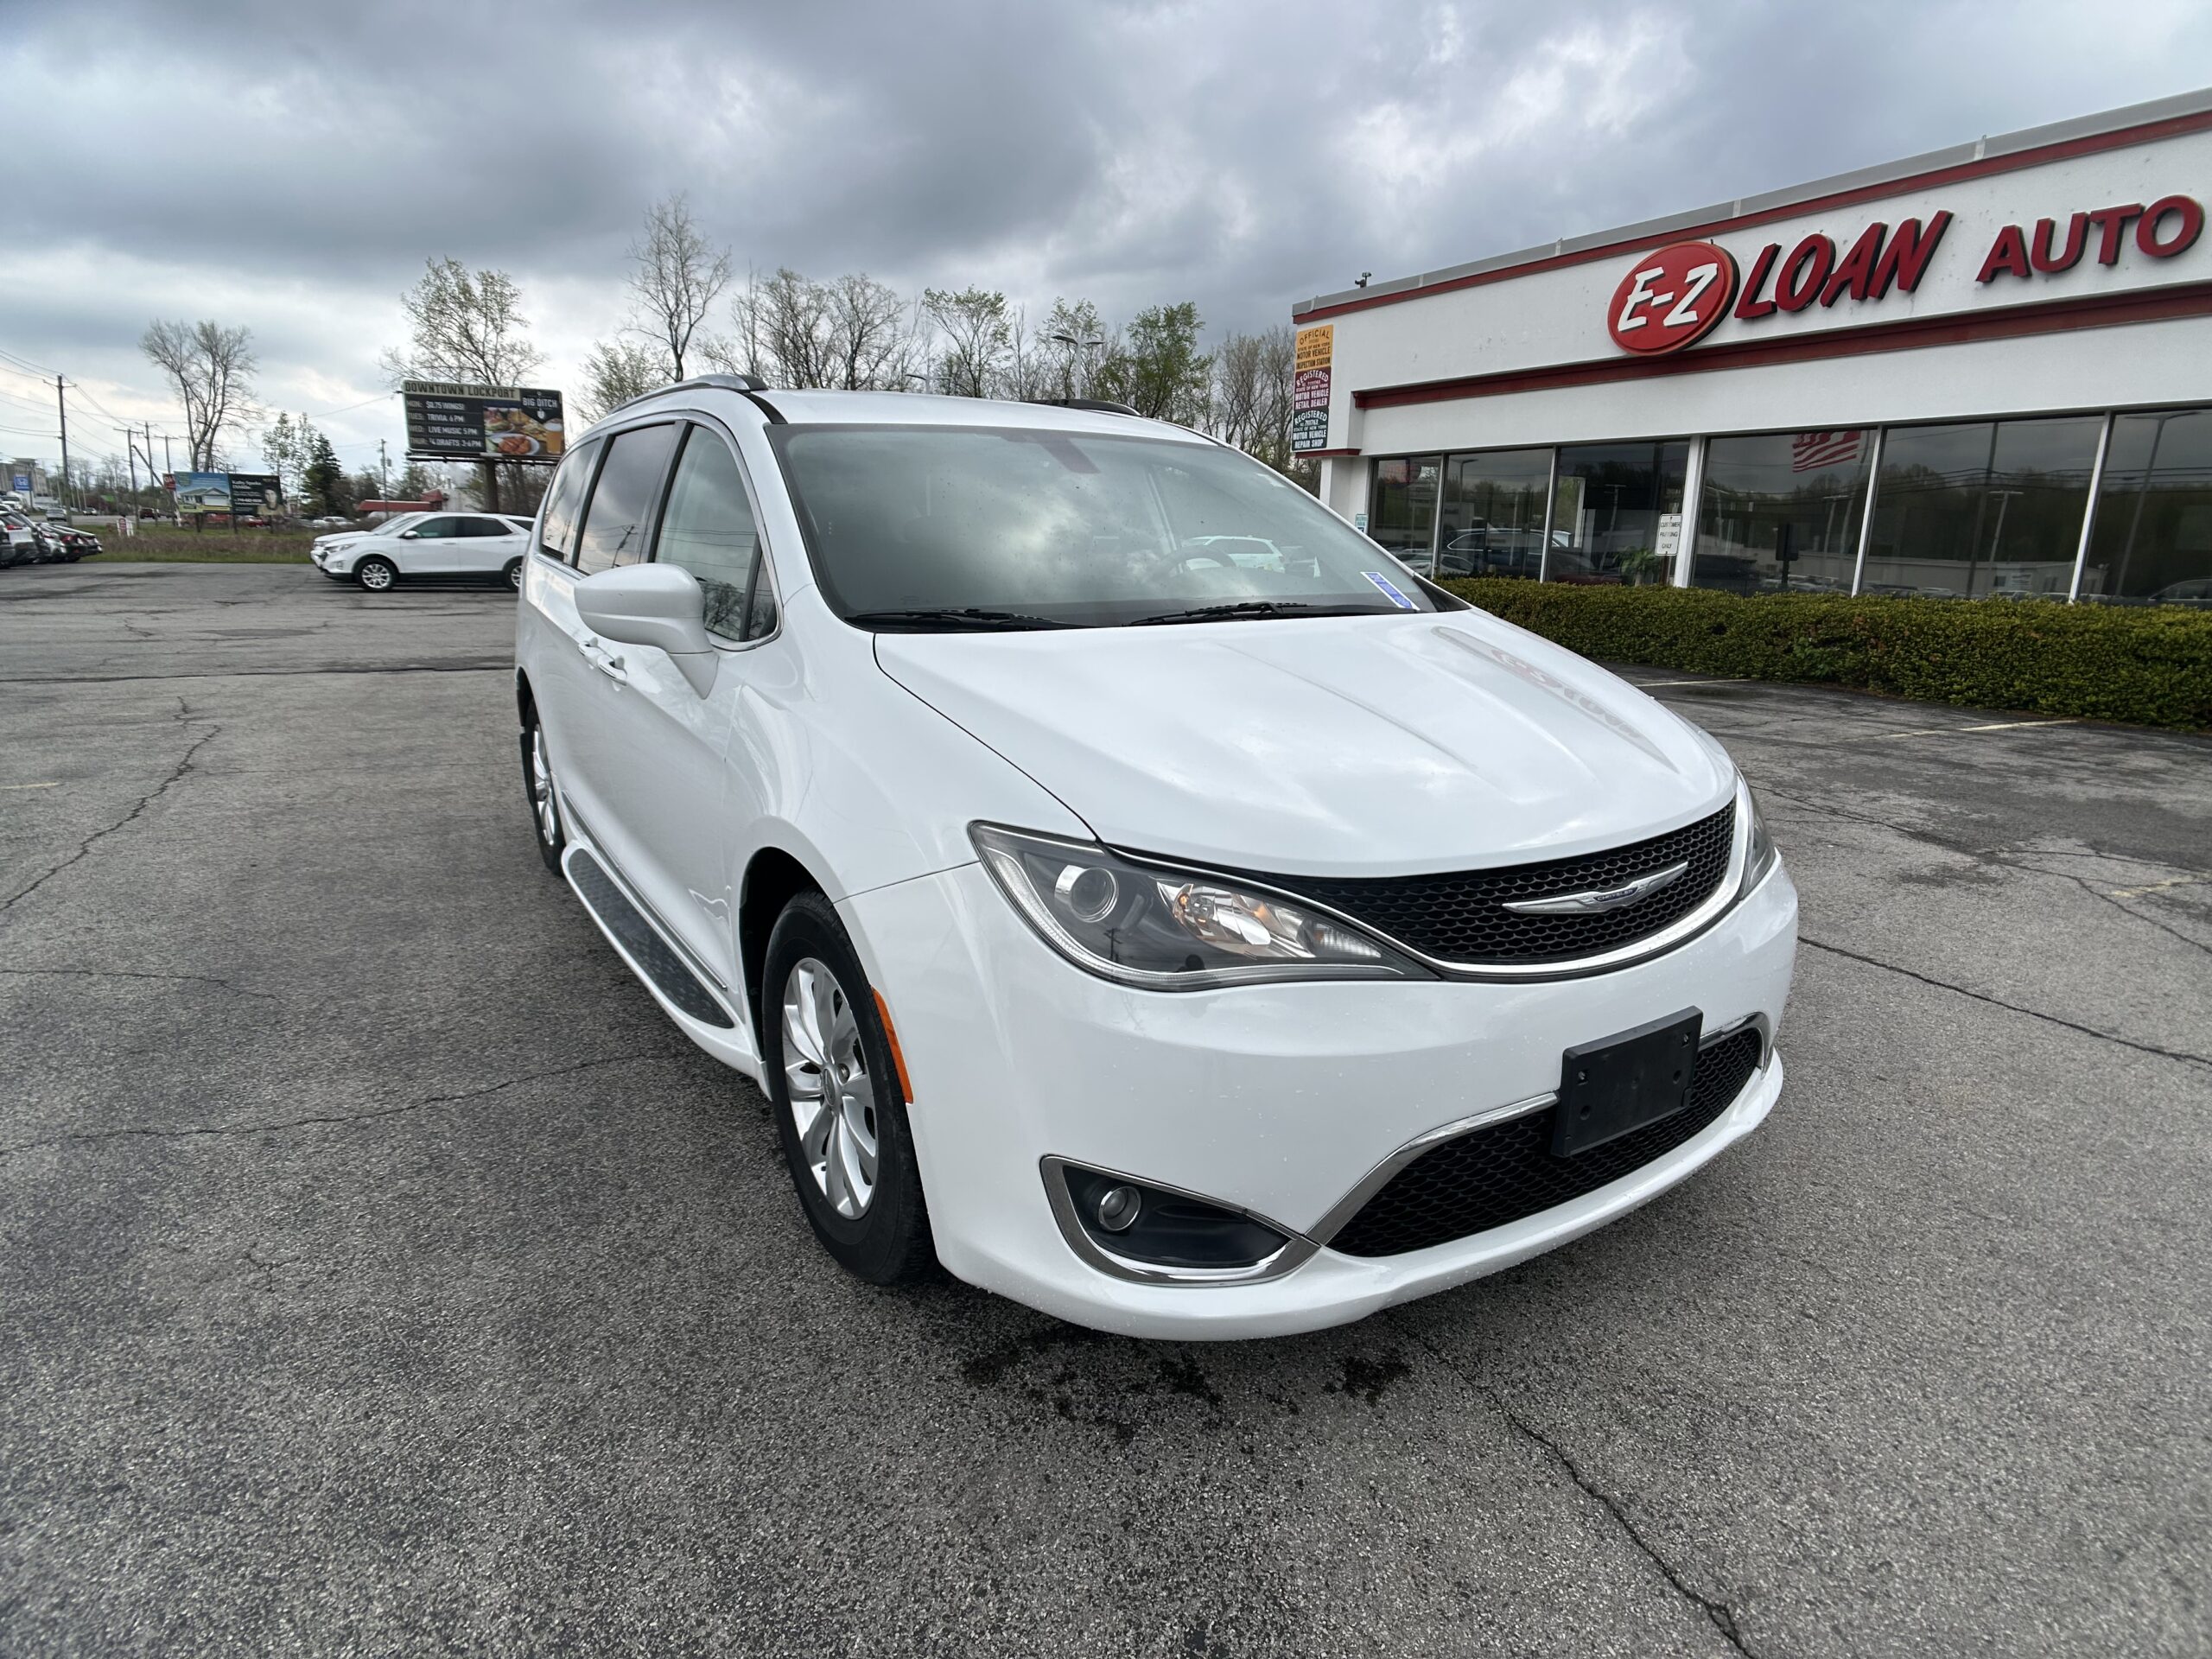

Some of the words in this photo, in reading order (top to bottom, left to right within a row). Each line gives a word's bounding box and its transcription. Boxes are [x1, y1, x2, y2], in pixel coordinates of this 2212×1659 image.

[1734, 210, 1954, 319] LOAN
[1975, 194, 2204, 283] AUTO
[1618, 263, 1719, 333] E-Z
[1300, 329, 1330, 345] OFFICIAL
[1297, 350, 1312, 359] MOTOR
[1313, 346, 1331, 357] VEHICLE
[1296, 369, 1329, 387] REGISTERED
[405, 382, 465, 396] DOWNTOWN
[468, 386, 516, 398] LOCKPORT
[1295, 391, 1310, 401] MOTOR
[1311, 388, 1329, 398] VEHICLE
[523, 397, 536, 406] BIG
[537, 398, 557, 408] DITCH
[1295, 400, 1310, 410] RETAIL
[1311, 397, 1327, 407] DEALER
[1294, 410, 1327, 425] REGISTERED
[428, 425, 442, 434] LIVE
[1293, 431, 1307, 441] MOTOR
[1309, 429, 1326, 439] VEHICLE
[1294, 440, 1310, 448] REPAIR
[1312, 439, 1323, 448] SHOP
[1598, 890, 1633, 900] CHRYSLER
